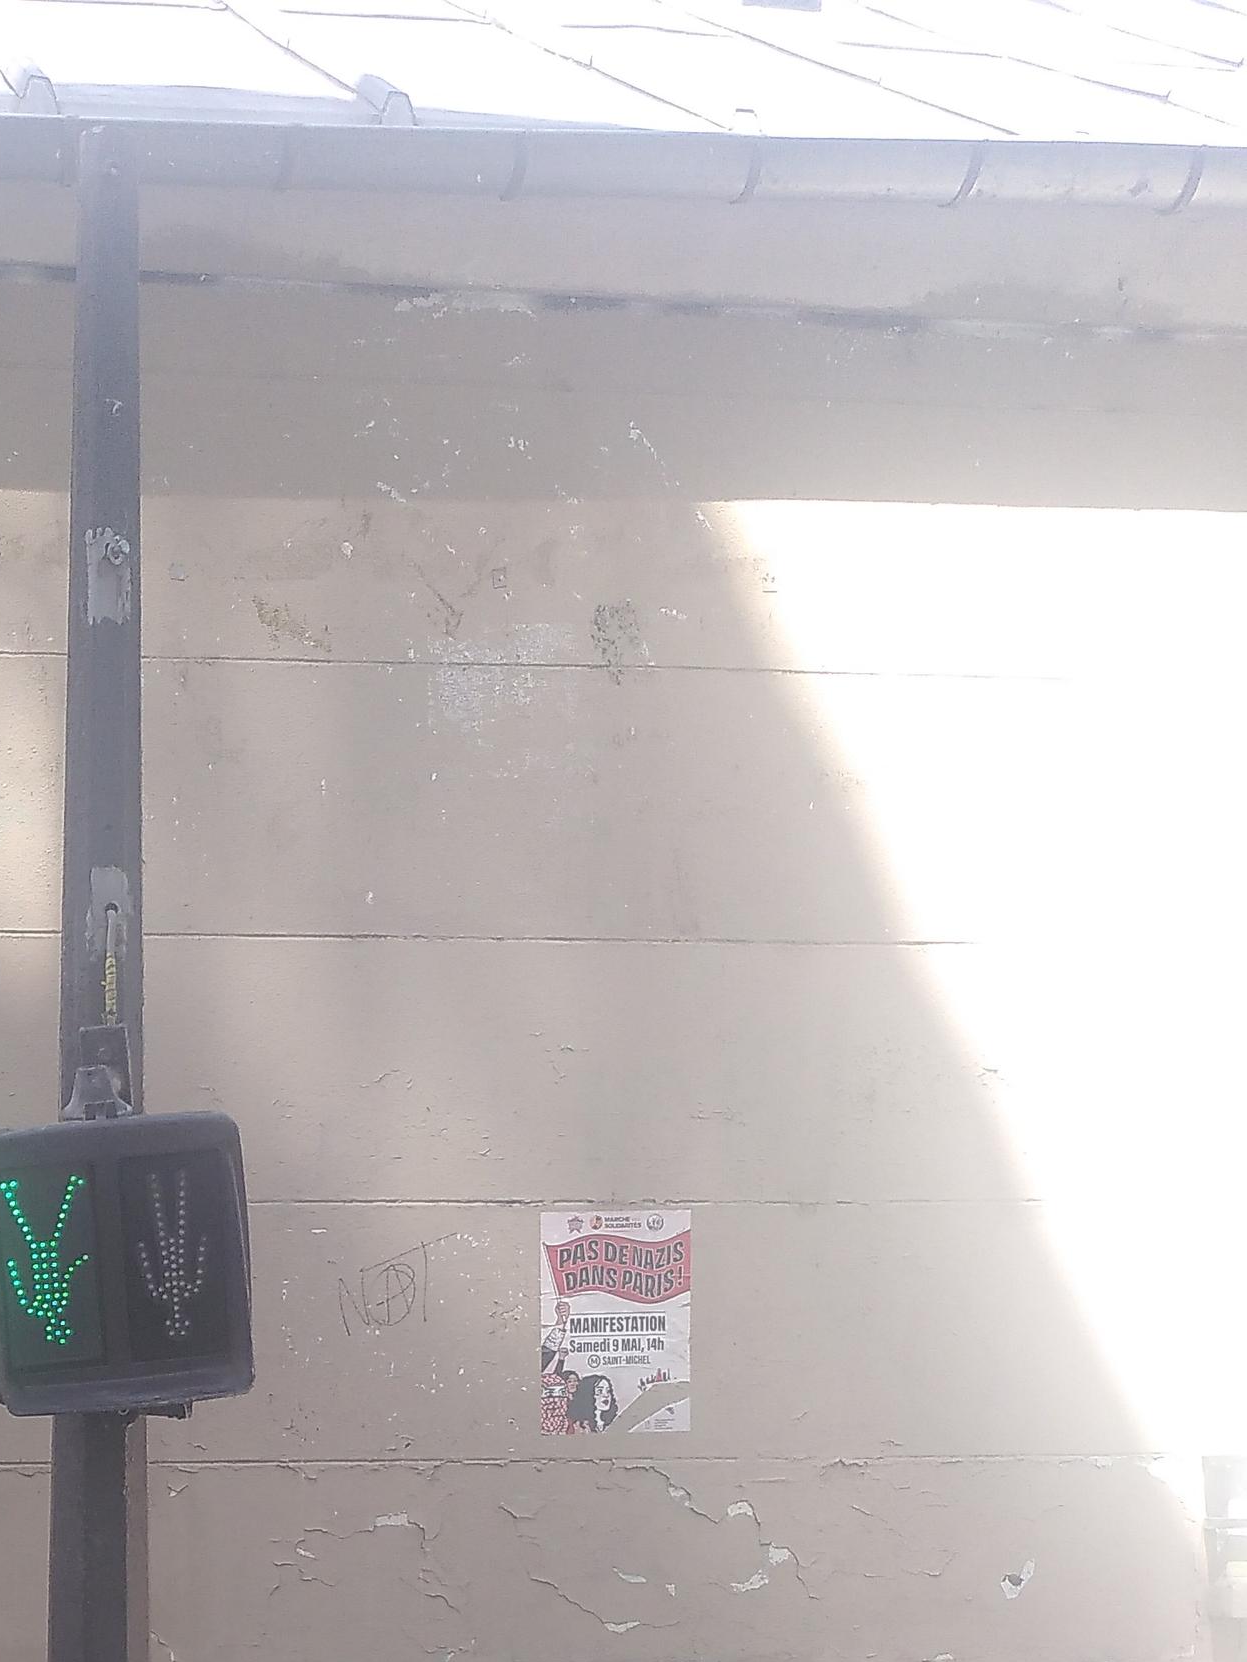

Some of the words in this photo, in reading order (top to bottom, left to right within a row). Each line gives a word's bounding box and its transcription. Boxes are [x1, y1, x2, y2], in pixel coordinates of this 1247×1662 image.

[559, 1240, 599, 1269] PAS
[604, 1241, 629, 1265] DE
[632, 1241, 684, 1270] NAZIS
[564, 1265, 618, 1291] DANS
[570, 1316, 665, 1333] MANIFESTATION
[569, 1338, 610, 1353] Samedi
[613, 1339, 619, 1352] 9
[621, 1338, 644, 1353] MAI,
[647, 1337, 664, 1351] 14h
[602, 1355, 651, 1365] SAINT-MICHEL
